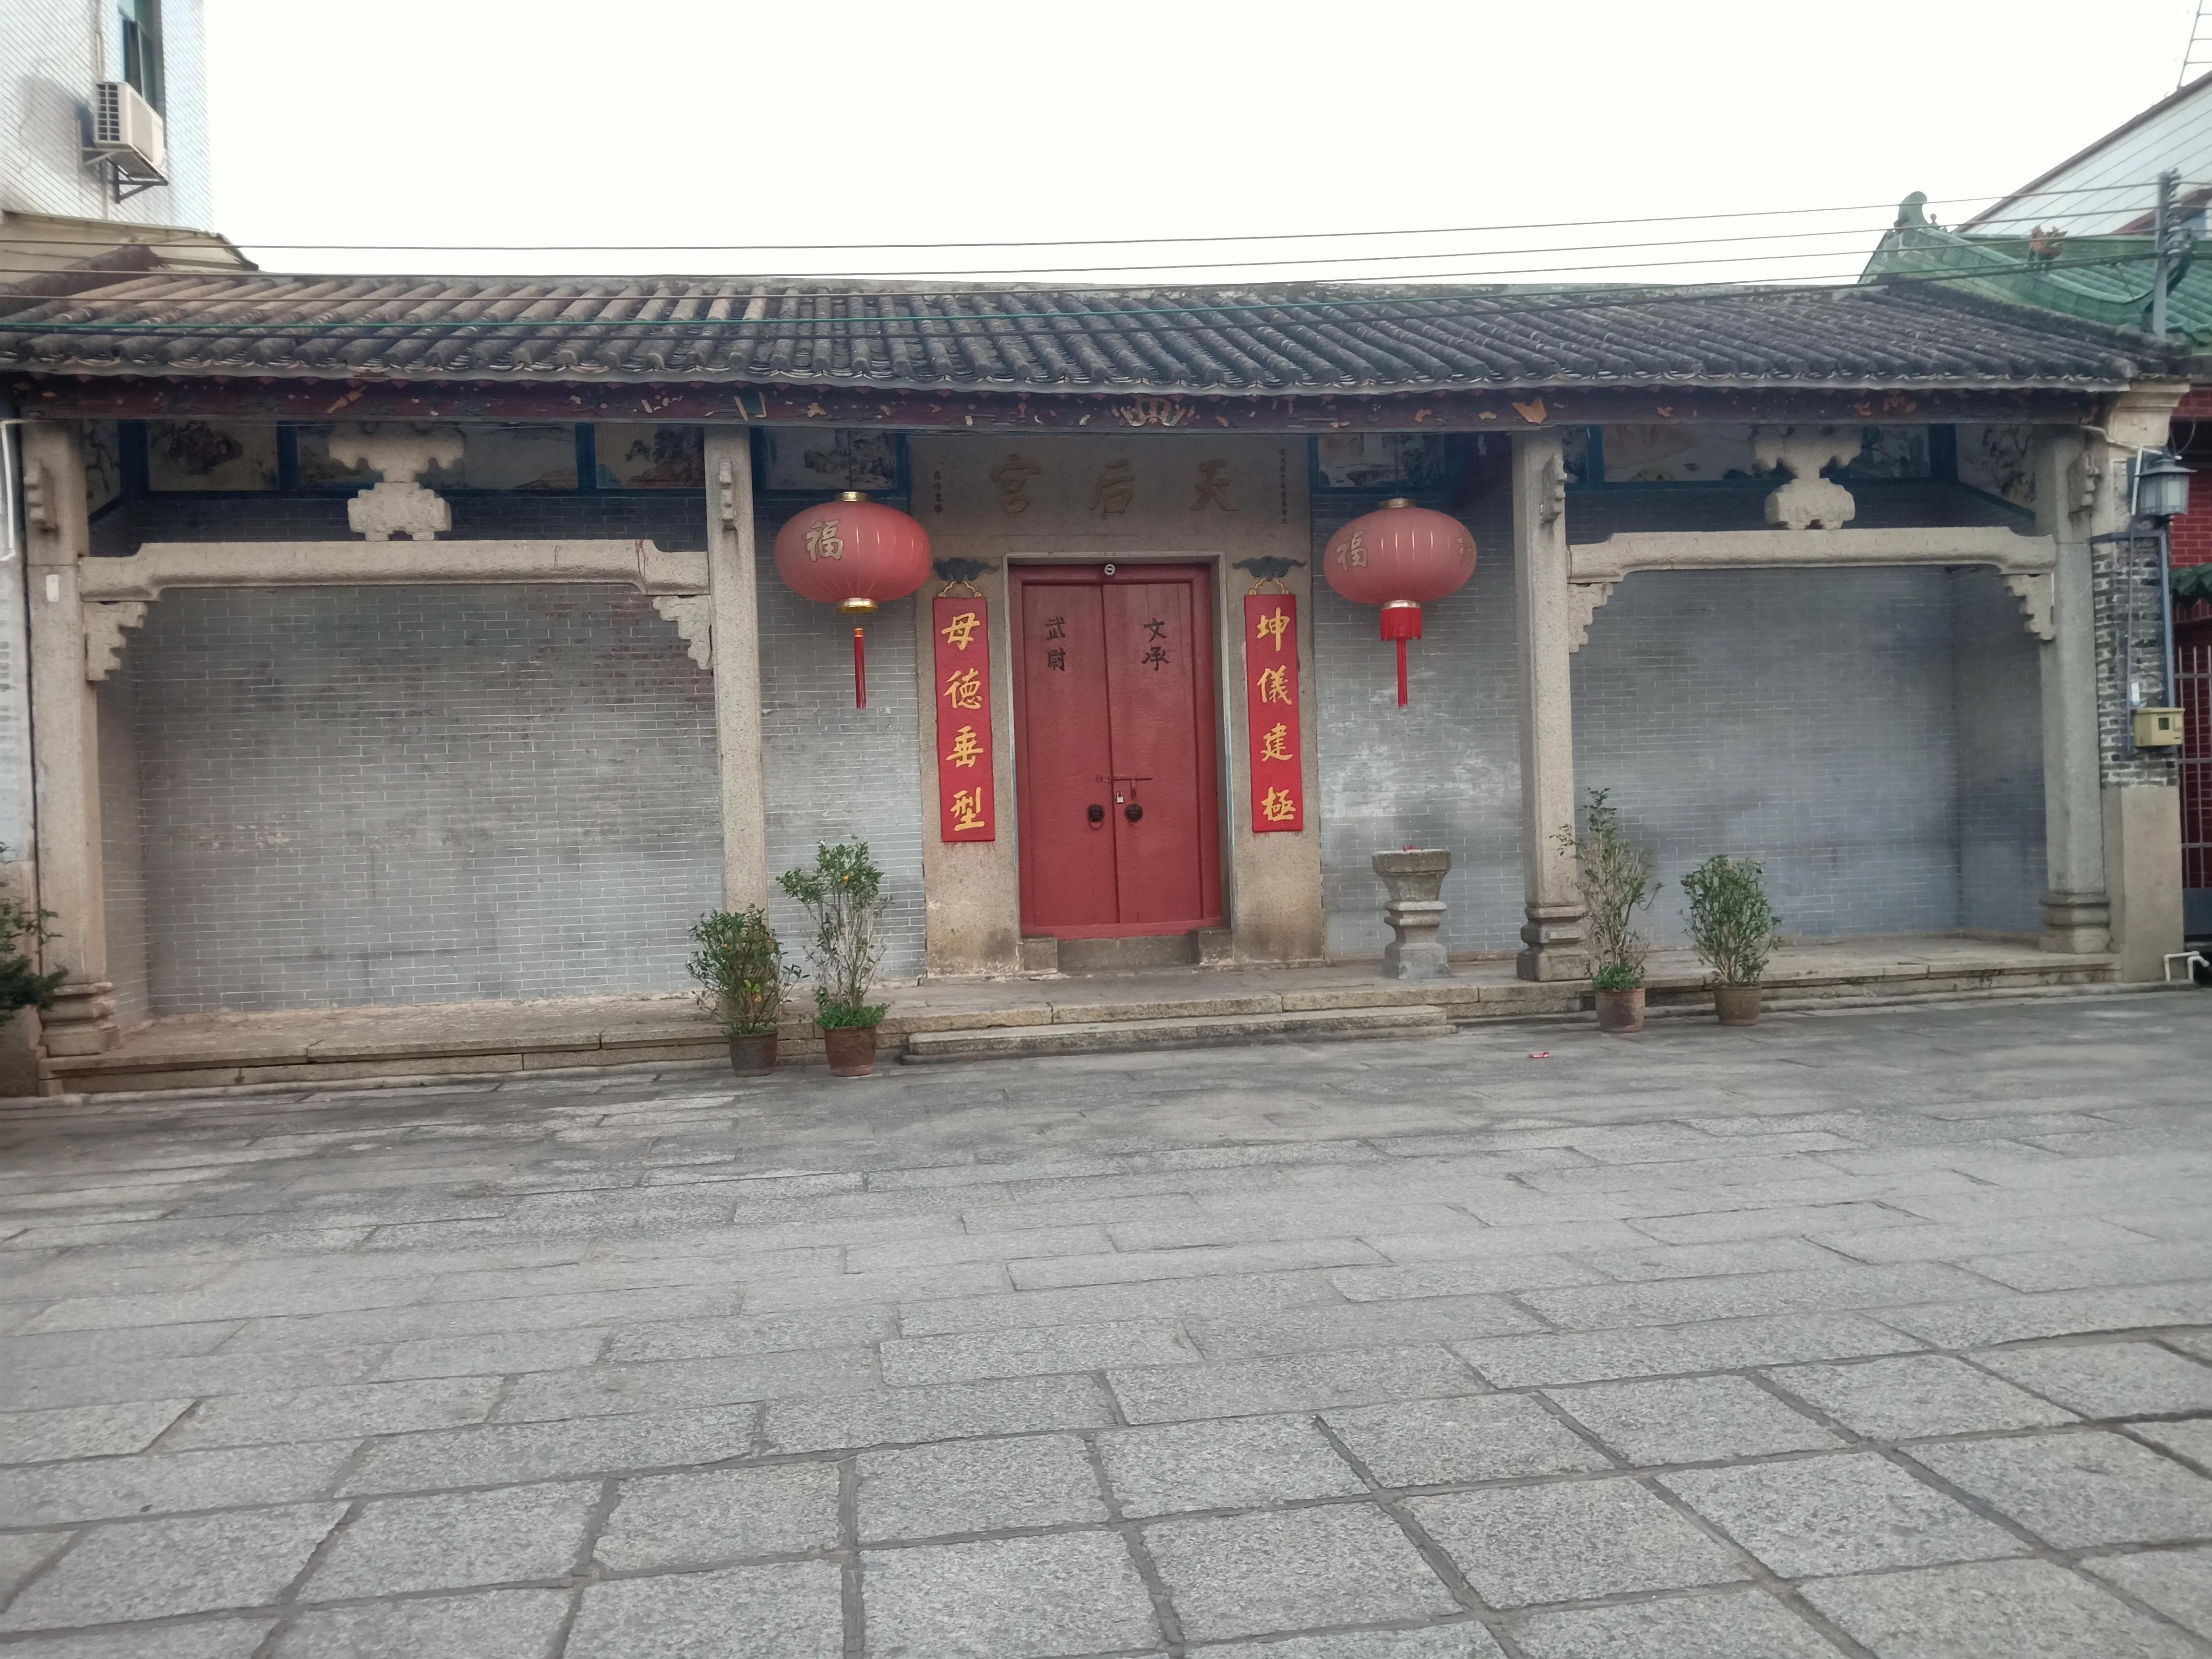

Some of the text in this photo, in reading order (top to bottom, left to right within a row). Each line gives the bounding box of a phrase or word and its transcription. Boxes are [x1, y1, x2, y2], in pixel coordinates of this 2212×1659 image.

[803, 519, 844, 562] 福
[1336, 530, 1369, 573] 福
[1045, 616, 1066, 672] 武尉
[1256, 607, 1297, 822] 坤儀建極
